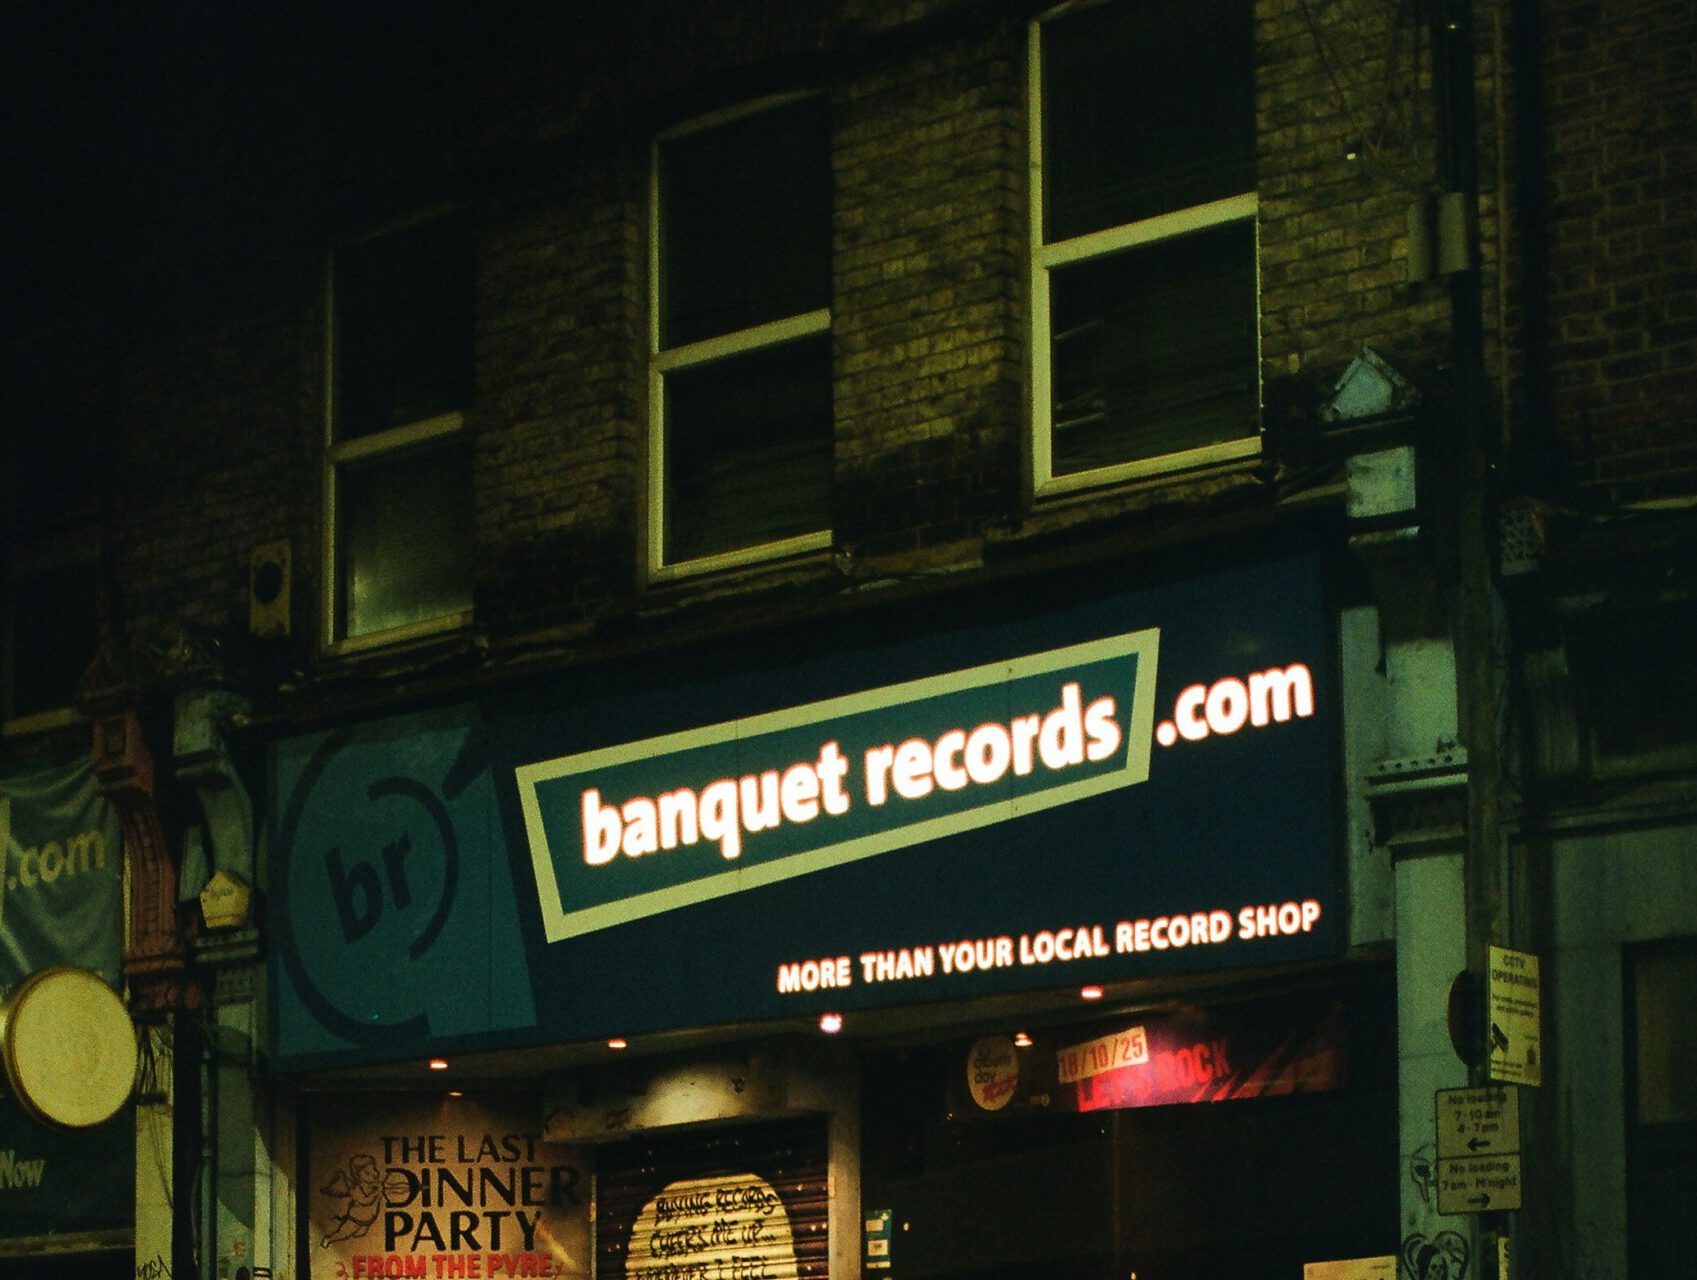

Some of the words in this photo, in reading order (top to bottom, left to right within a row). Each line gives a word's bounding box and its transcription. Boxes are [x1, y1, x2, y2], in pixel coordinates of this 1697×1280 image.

[1155, 662, 1314, 748] .com
[581, 739, 851, 867] banquet
[864, 681, 1123, 806] records
[324, 832, 413, 946] br
[777, 955, 852, 995] MORE
[859, 945, 934, 984] THAN
[940, 935, 1013, 975] YOUR
[1019, 926, 1110, 966] LOCAL
[1115, 909, 1232, 955] RECORD
[1238, 899, 1322, 940] SHOP
[380, 1134, 446, 1165] THE
[457, 1134, 541, 1164] LAST
[382, 1165, 582, 1209] DINNER
[384, 1209, 542, 1252] PARTY
[352, 1254, 426, 1280] FROM
[432, 1253, 482, 1280] THE
[487, 1252, 556, 1279] PYRE
